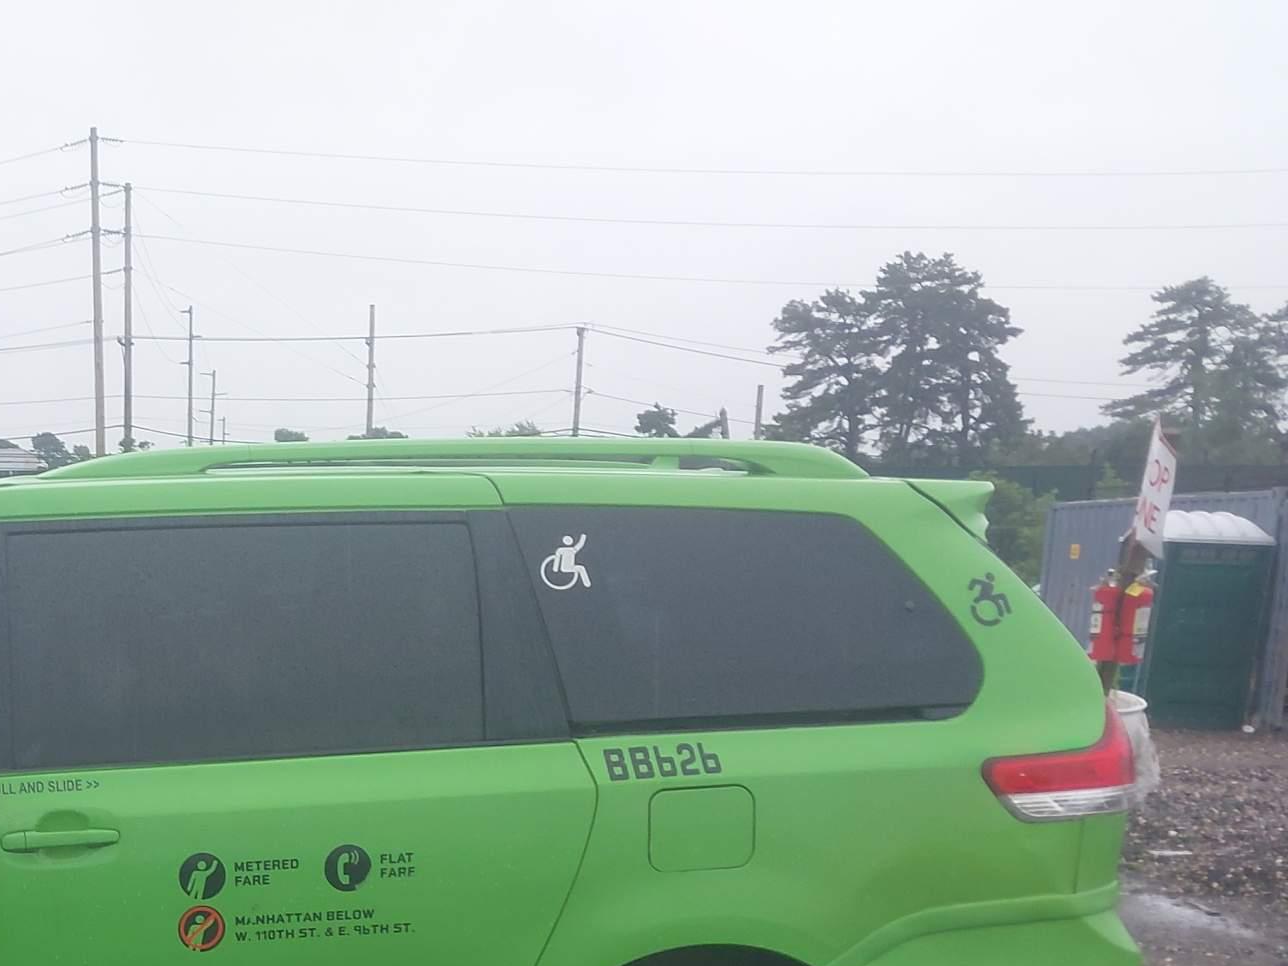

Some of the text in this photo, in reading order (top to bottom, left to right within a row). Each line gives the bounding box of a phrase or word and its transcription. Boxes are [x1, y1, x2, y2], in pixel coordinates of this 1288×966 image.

[603, 743, 722, 781] BB626
[19, 781, 44, 794] AND
[48, 779, 83, 792] SLIDE
[234, 858, 300, 873] METERED
[379, 852, 415, 865] FLAT
[234, 874, 271, 888] FARE
[326, 909, 375, 921] BELOW
[235, 923, 416, 942] W. 110TH ST. & E. 96TH ST.
